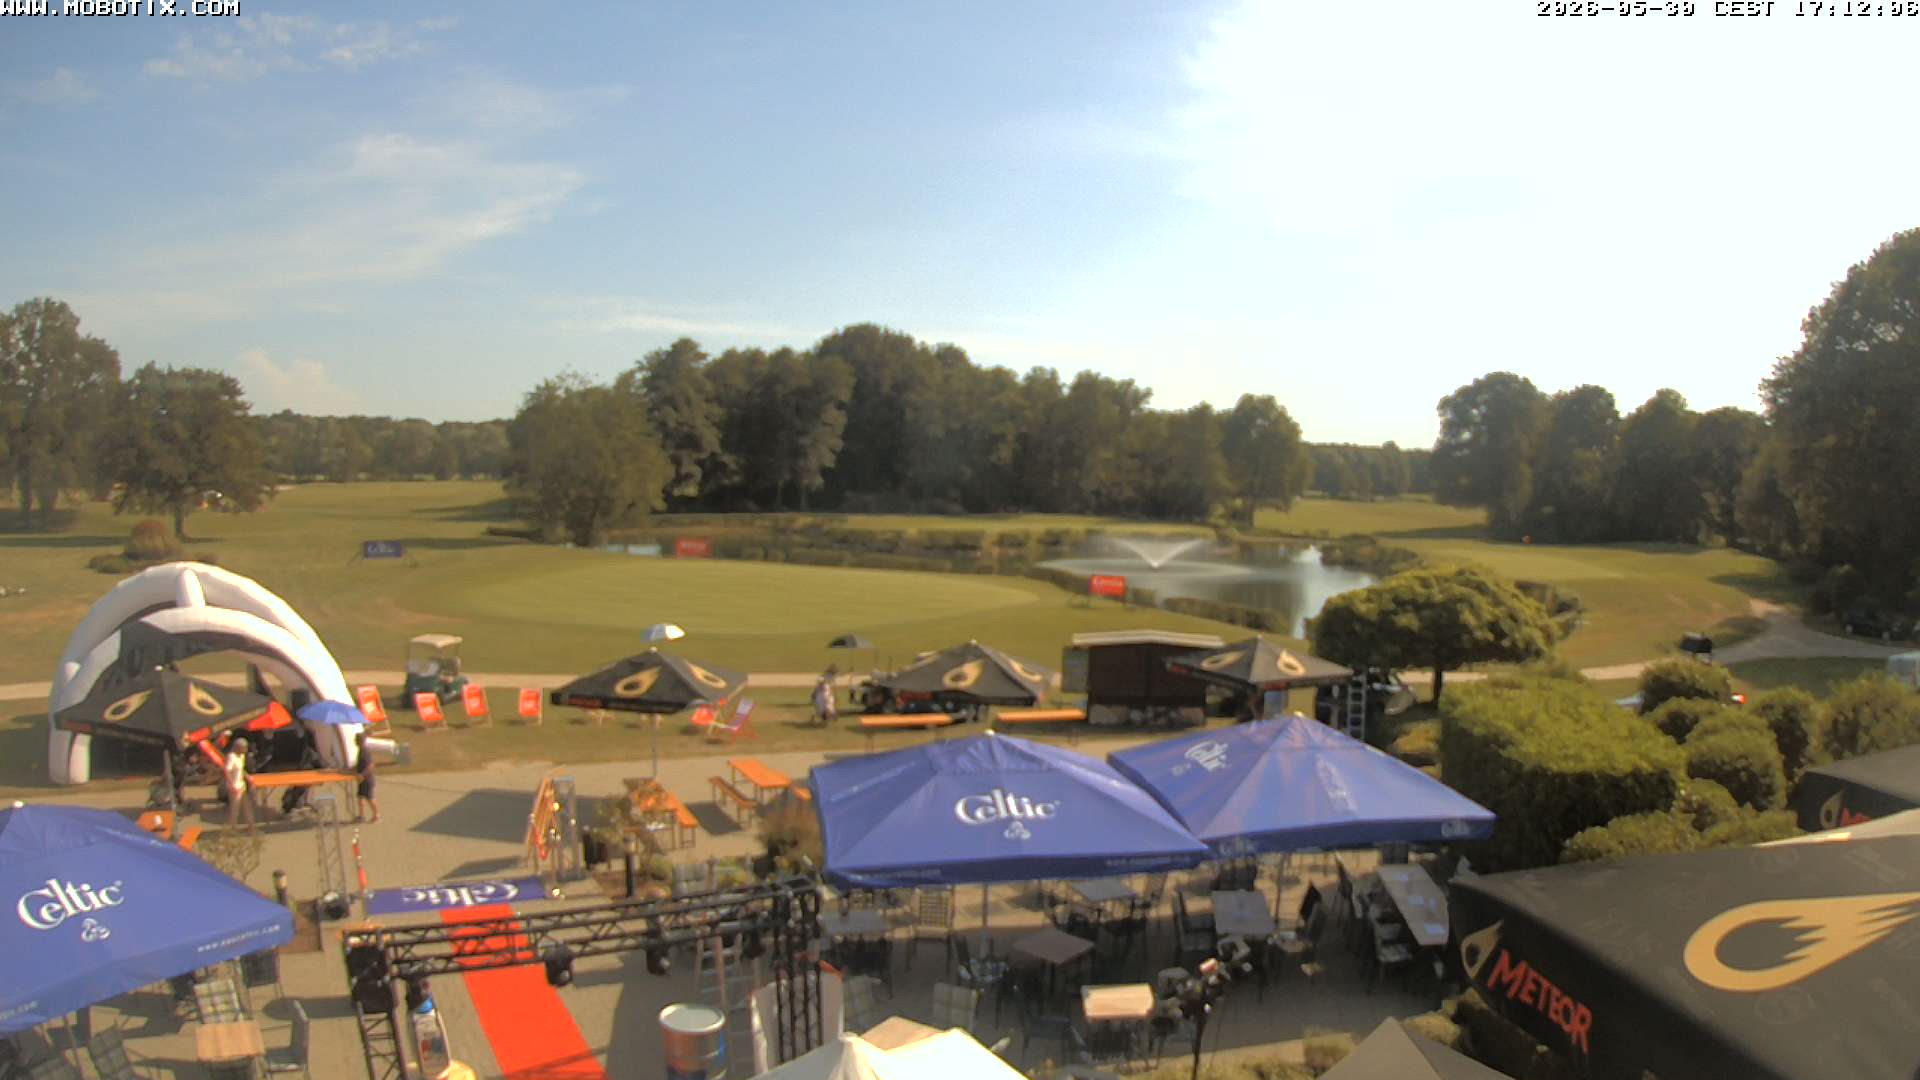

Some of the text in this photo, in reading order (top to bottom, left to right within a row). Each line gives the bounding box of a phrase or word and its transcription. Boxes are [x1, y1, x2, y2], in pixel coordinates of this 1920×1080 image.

[953, 788, 1056, 824] Celtic
[17, 879, 124, 930] Celtic
[402, 884, 518, 906] Celtic
[1487, 949, 1592, 1055] METEOR
